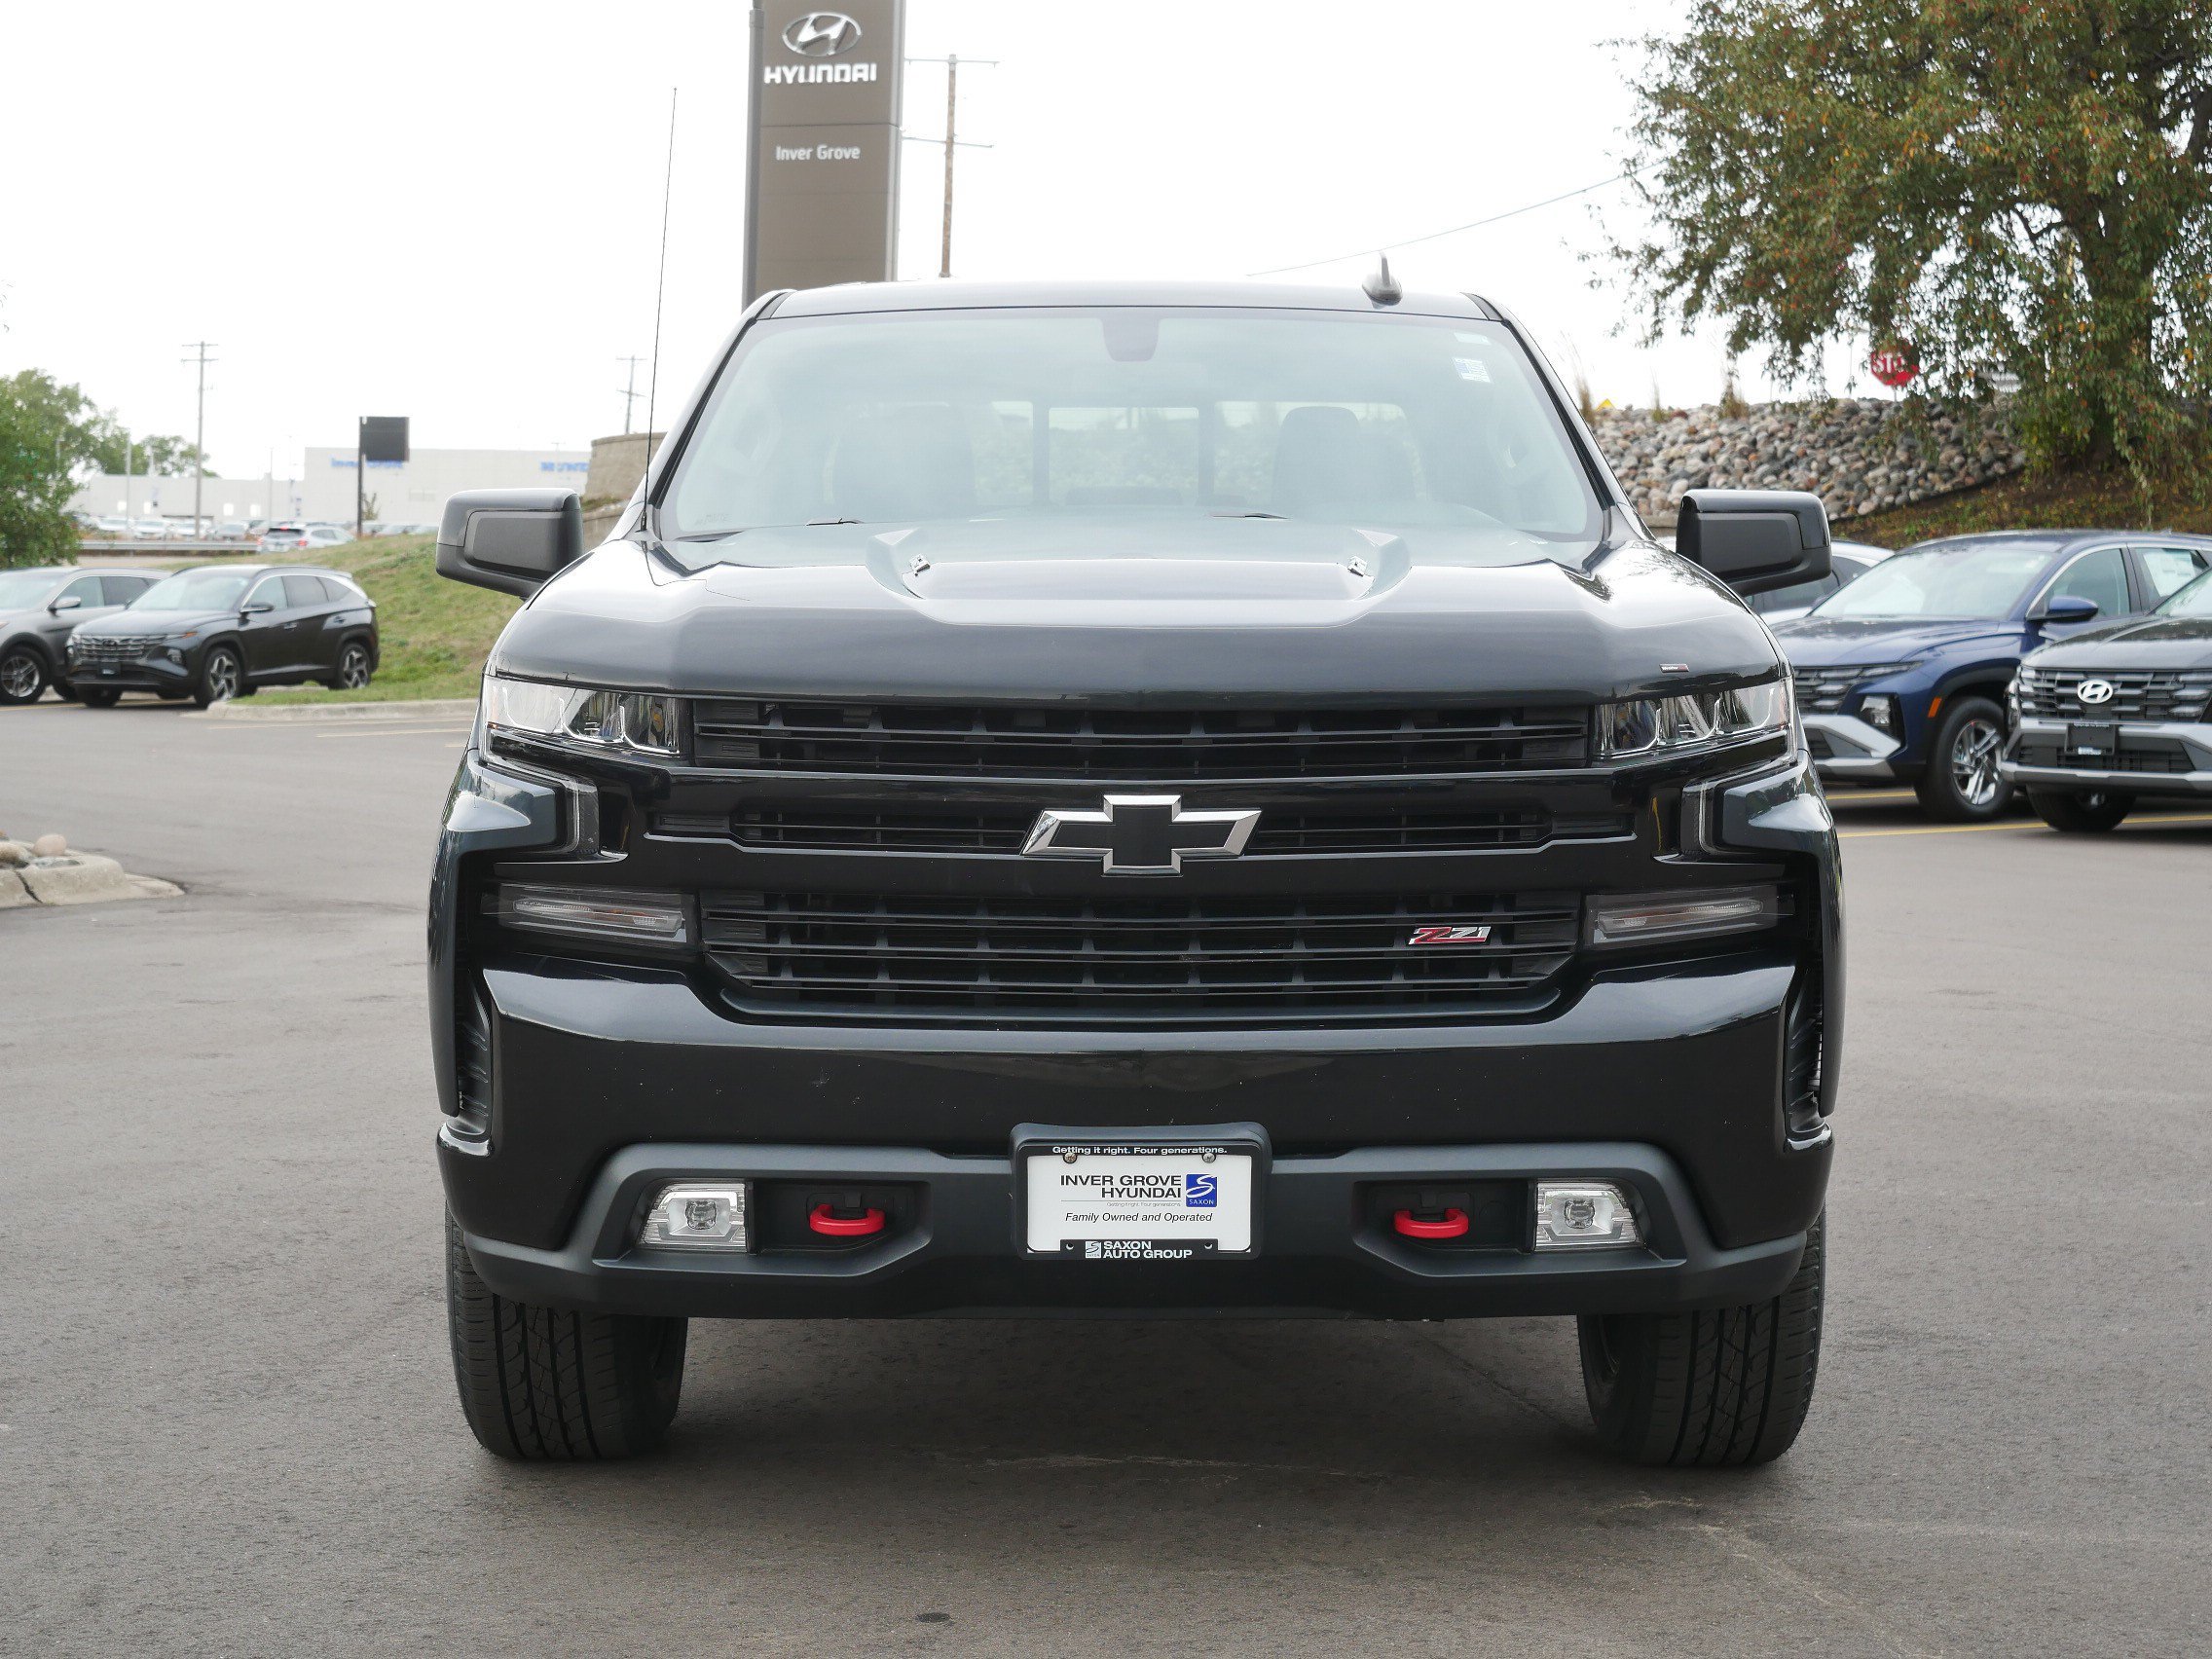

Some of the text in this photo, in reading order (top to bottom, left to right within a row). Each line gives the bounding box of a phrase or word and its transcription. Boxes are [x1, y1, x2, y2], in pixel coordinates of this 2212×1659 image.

[763, 63, 877, 84] HYUNDAI
[776, 144, 861, 161] Inver Grove
[1871, 351, 1909, 374] STO
[1051, 1146, 1091, 1156] Getting
[1103, 1146, 1130, 1156] right.
[1161, 1146, 1228, 1156] generations.
[1060, 1174, 1182, 1186] INVER GROVE
[1101, 1187, 1181, 1198] HYUNDAI
[1065, 1212, 1213, 1224] Family Owned and Operated
[1103, 1240, 1152, 1250] SAXON
[1102, 1249, 1193, 1259] AUTO GROUP
